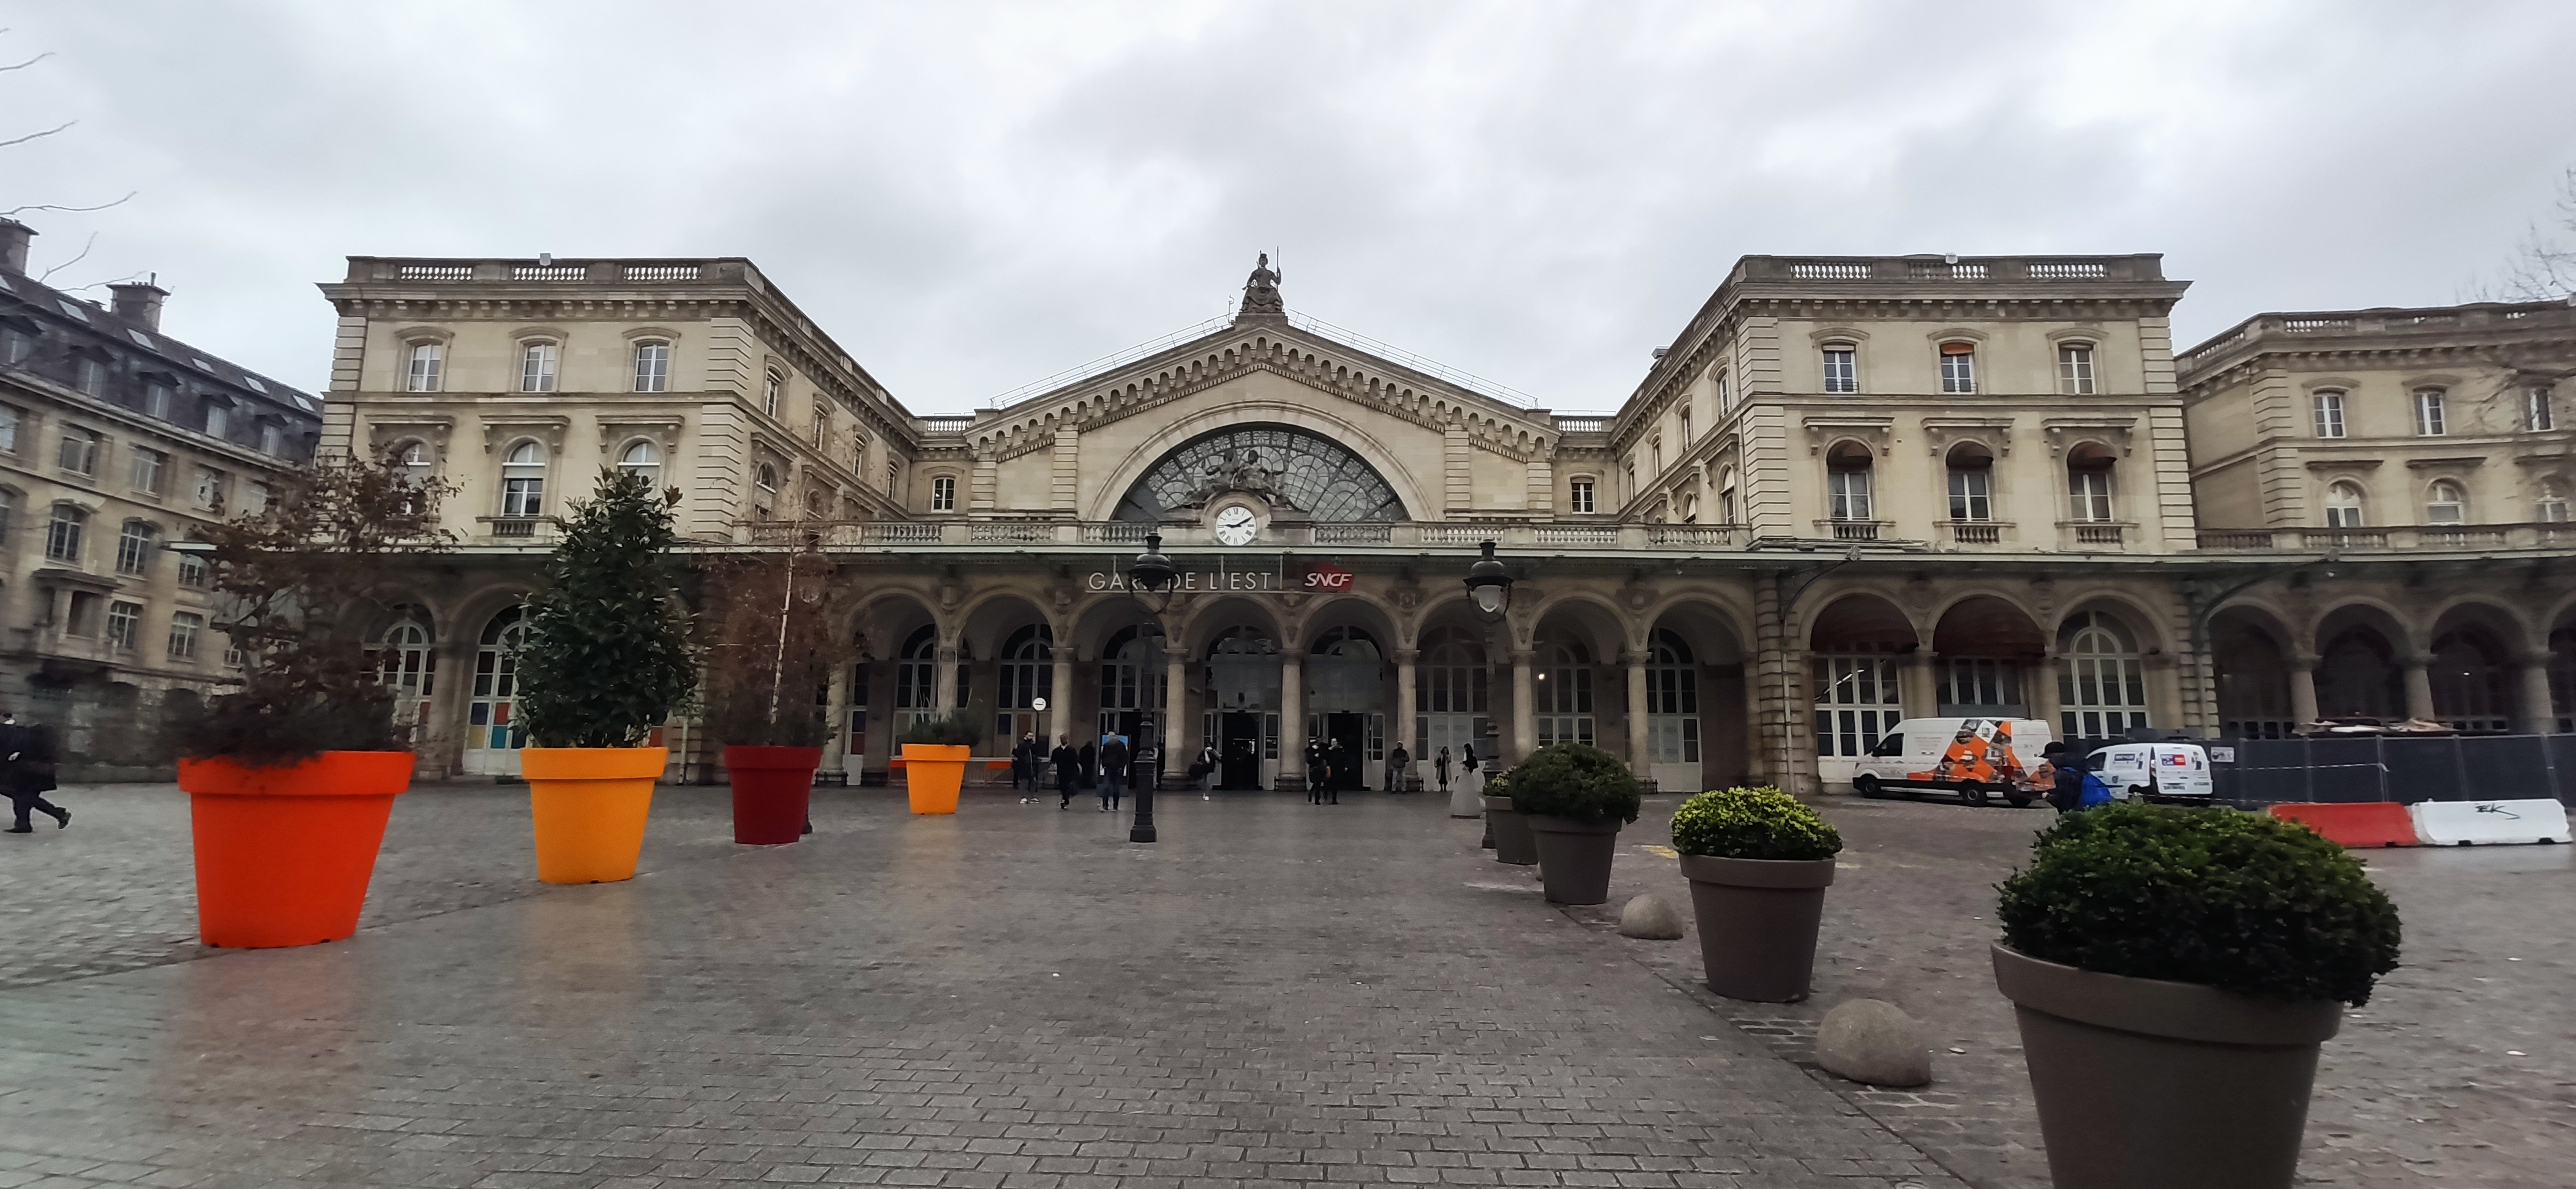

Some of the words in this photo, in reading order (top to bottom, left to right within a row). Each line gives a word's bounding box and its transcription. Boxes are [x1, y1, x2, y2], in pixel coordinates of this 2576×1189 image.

[1089, 572, 1150, 590] GA
[1167, 572, 1196, 590] DE
[1210, 572, 1271, 590] L'EST
[1304, 572, 1352, 587] SNCF
